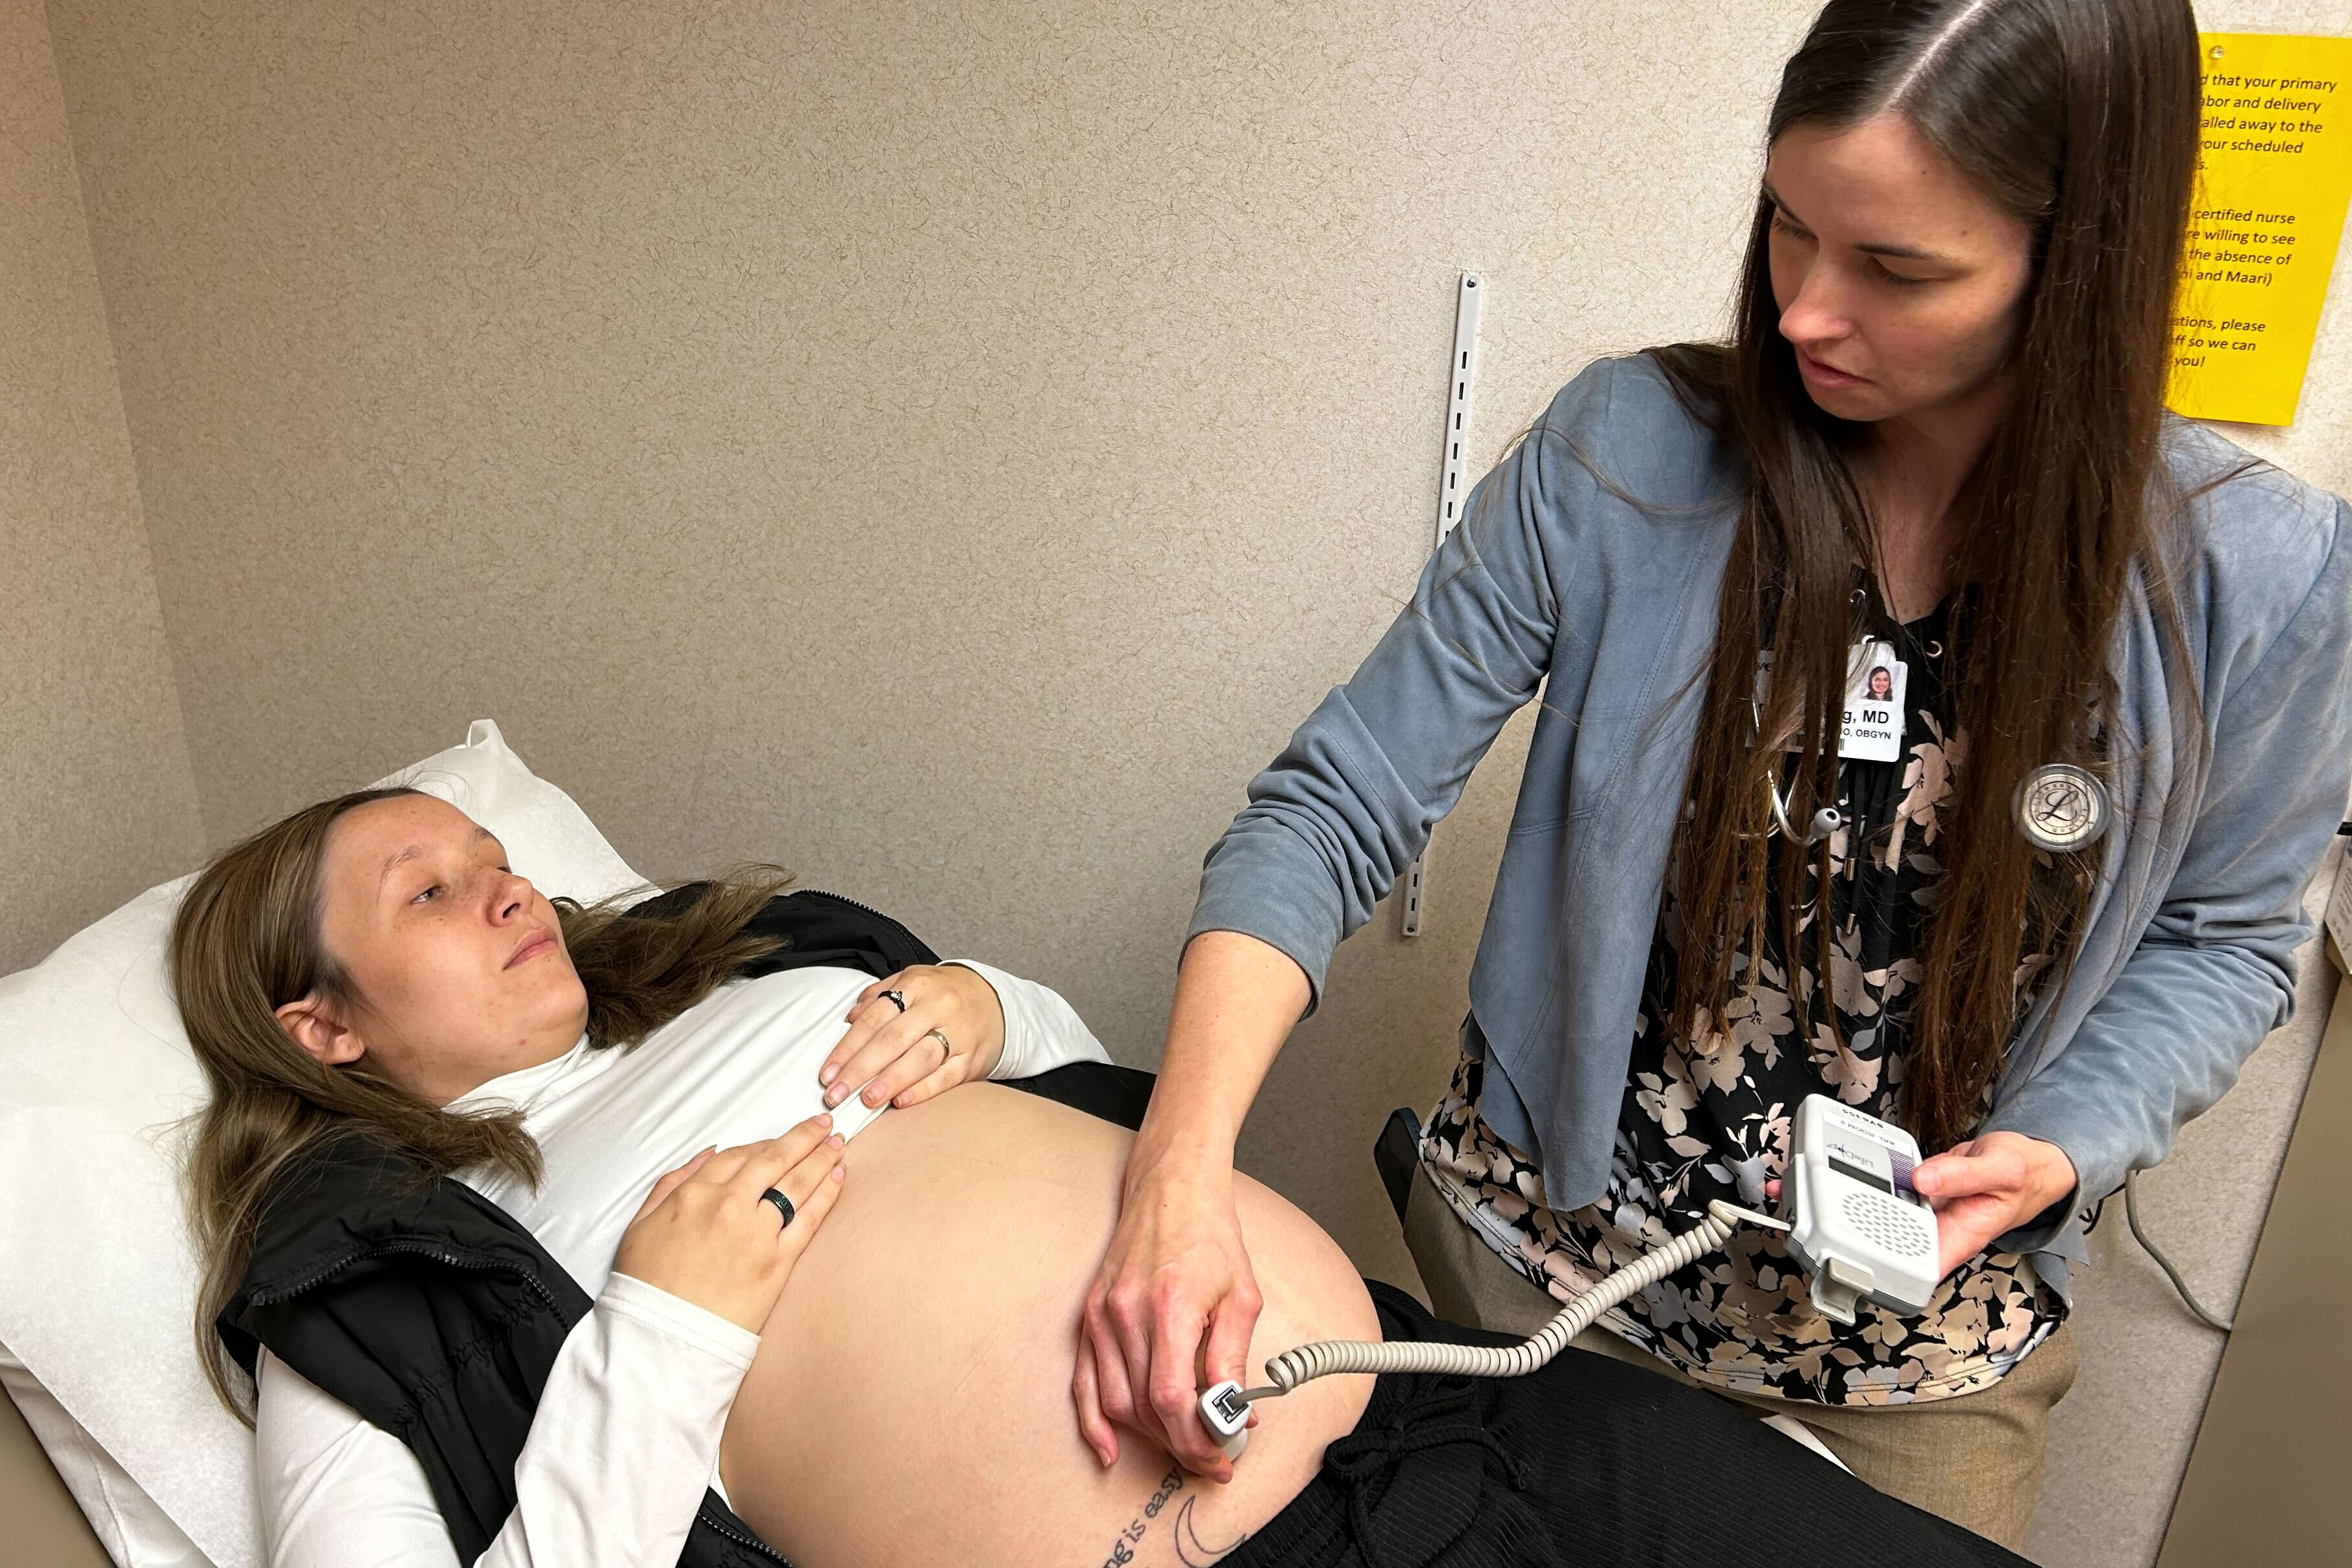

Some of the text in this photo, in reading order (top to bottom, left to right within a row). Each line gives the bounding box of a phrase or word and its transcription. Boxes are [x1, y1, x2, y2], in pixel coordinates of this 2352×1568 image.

[2212, 73, 2241, 86] that
[2244, 77, 2277, 90] your
[2279, 77, 2338, 93] primary
[2233, 97, 2260, 109] and
[2264, 97, 2321, 114] delivery
[2238, 121, 2277, 133] away
[2280, 121, 2295, 132] to
[2299, 121, 2323, 133] the
[2230, 139, 2304, 154] scheduled
[2194, 208, 2296, 225] certified nurse
[2204, 228, 2249, 245] willing
[2253, 231, 2268, 243] to
[2271, 235, 2296, 245] see
[2189, 249, 2293, 265] the absence of
[2196, 270, 2223, 282] and
[2225, 271, 2272, 286] Maari)
[2220, 318, 2266, 332] please
[2188, 338, 2204, 347] so
[2208, 339, 2229, 349] we
[2232, 341, 2256, 351] can
[2174, 356, 2206, 367] you!
[1843, 709, 1889, 724] g, MD
[1856, 729, 1891, 740] OBGYN
[1121, 1519, 1146, 1543] is
[1144, 1466, 1183, 1518] easy
